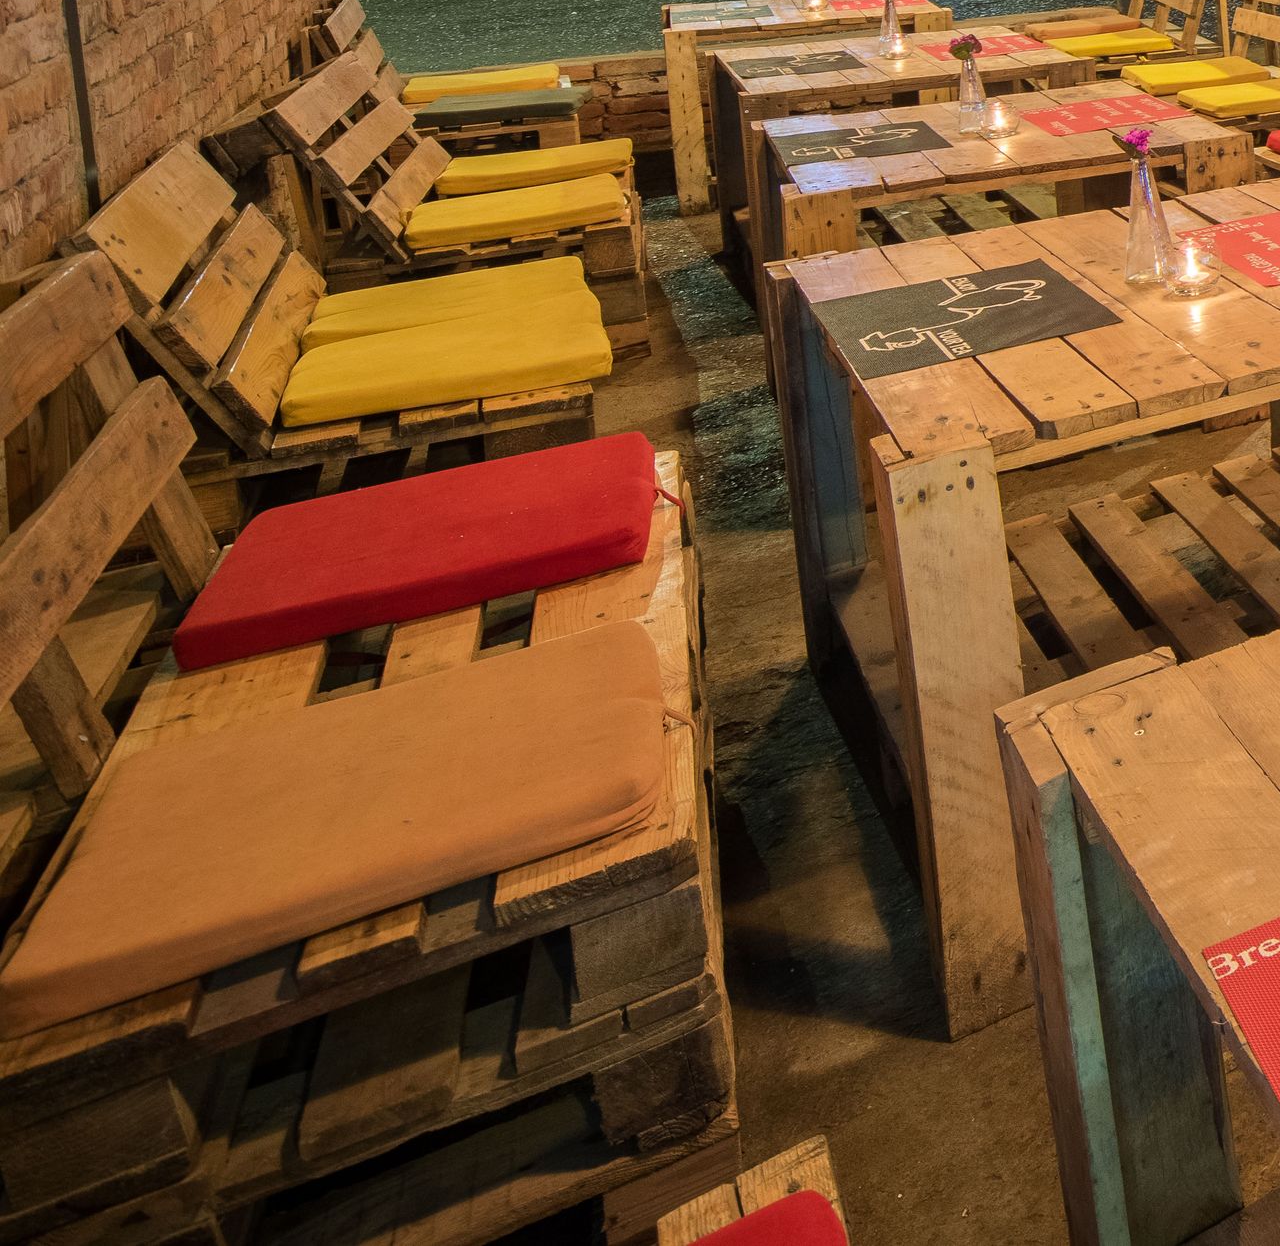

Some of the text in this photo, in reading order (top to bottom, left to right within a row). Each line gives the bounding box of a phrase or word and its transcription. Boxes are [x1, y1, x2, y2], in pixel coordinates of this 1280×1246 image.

[951, 277, 979, 291] ENJOY
[937, 329, 973, 355] YOUR TEA
